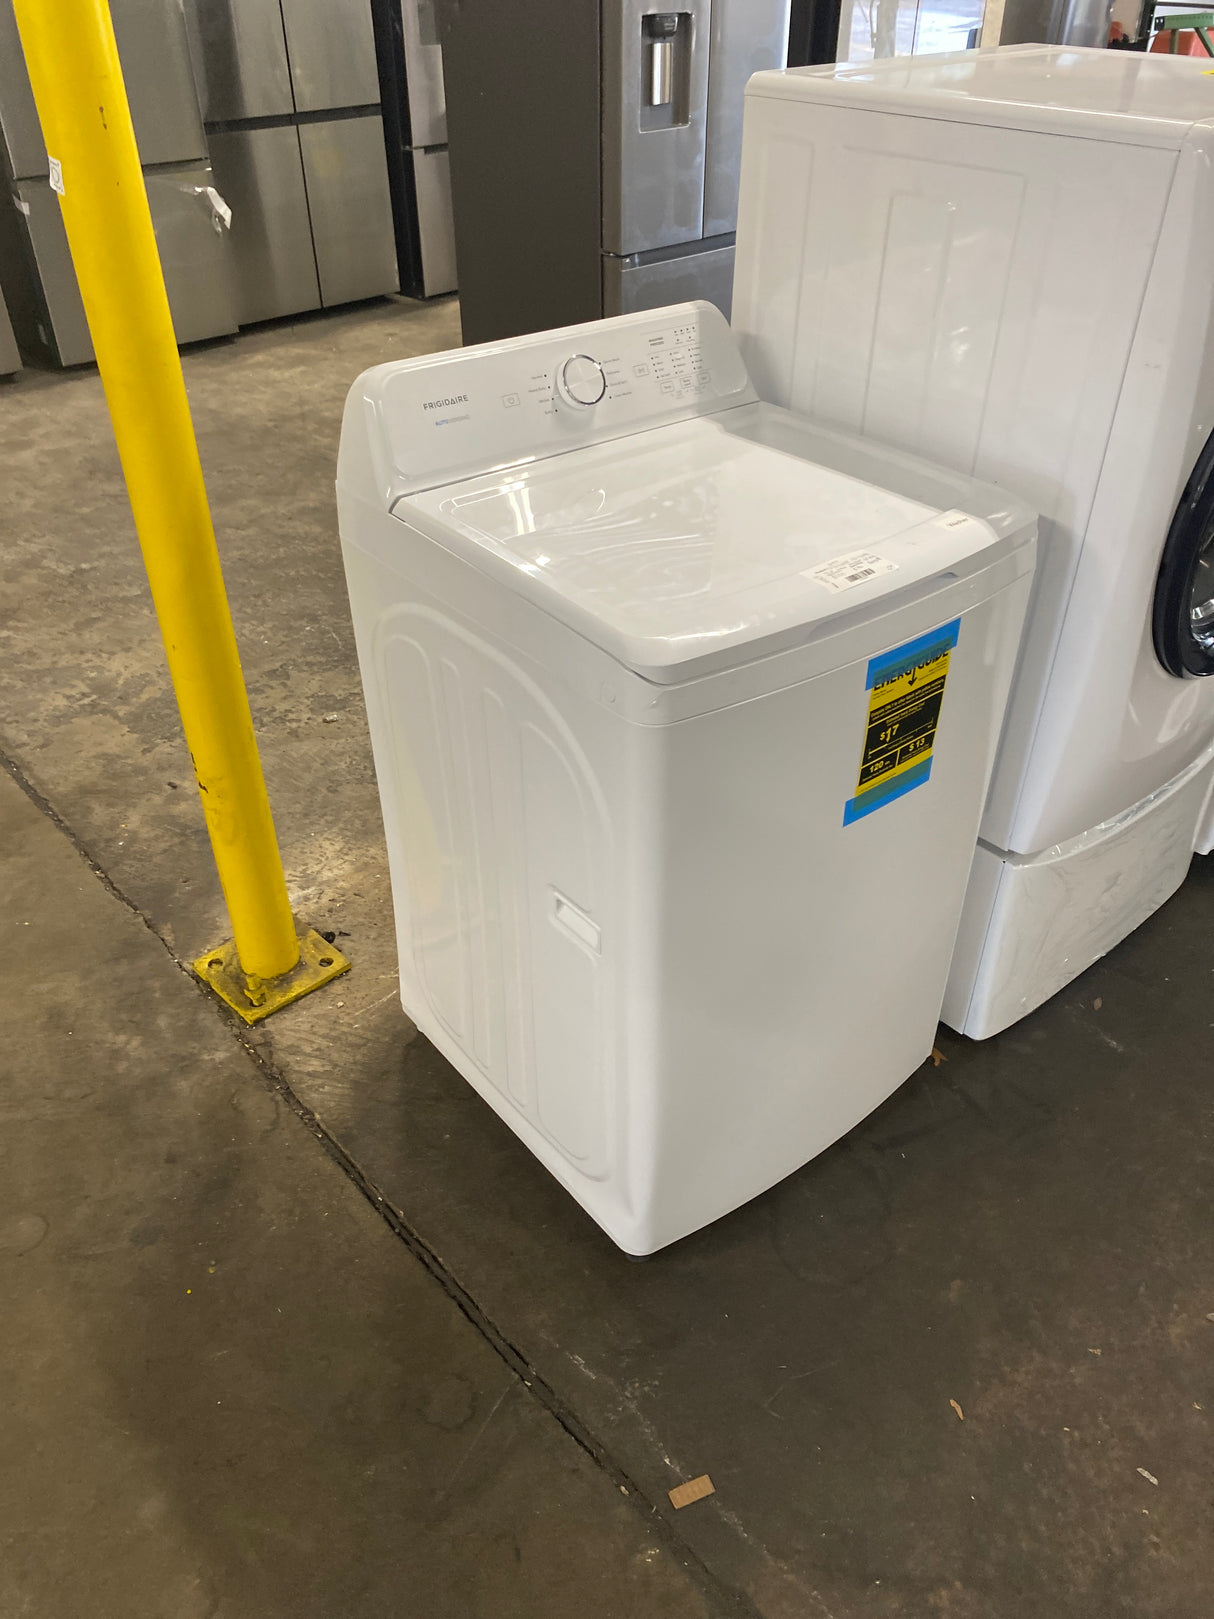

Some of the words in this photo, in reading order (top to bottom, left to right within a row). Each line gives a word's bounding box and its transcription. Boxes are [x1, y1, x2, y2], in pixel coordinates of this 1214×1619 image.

[422, 394, 469, 411] FRIGIDAIRE
[880, 723, 900, 743] $17
[869, 760, 884, 773] 120
